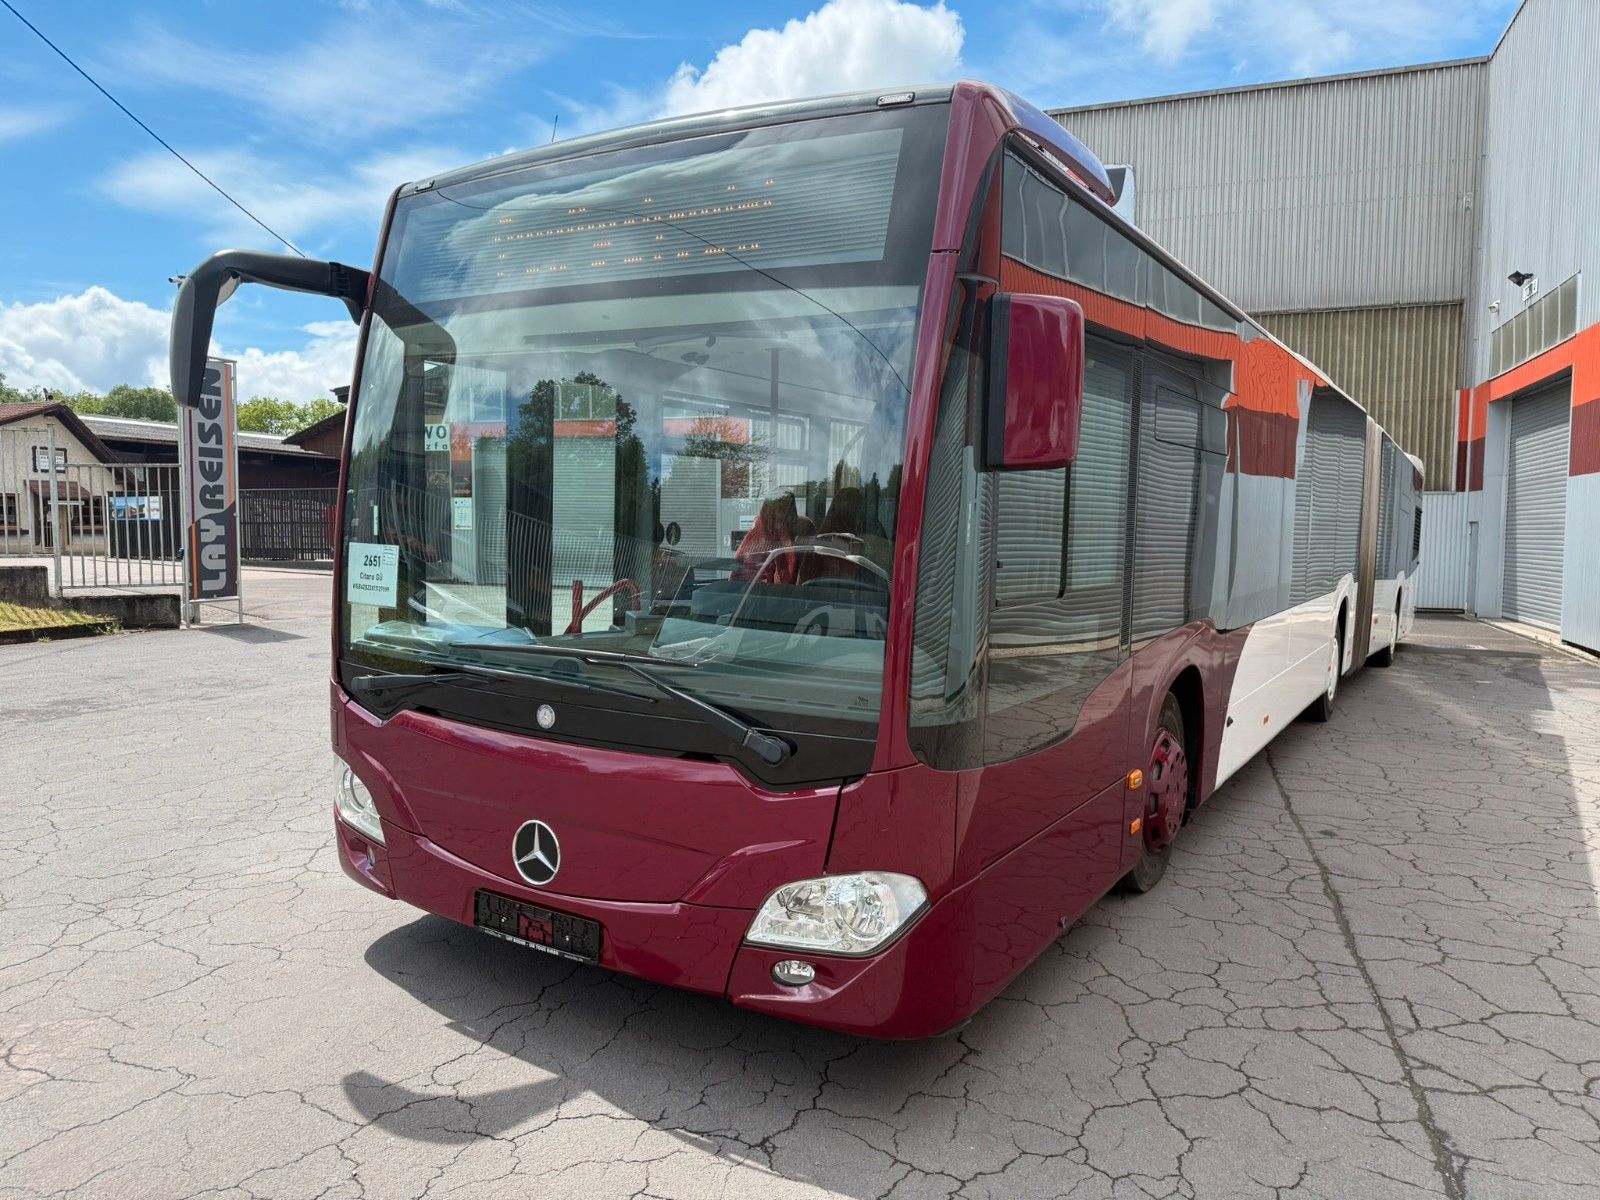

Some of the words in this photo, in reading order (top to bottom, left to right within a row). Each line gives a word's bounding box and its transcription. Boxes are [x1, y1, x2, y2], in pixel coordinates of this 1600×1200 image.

[198, 367, 225, 510] REISEN
[200, 519, 226, 591] LAY
[363, 555, 381, 567] 2651
